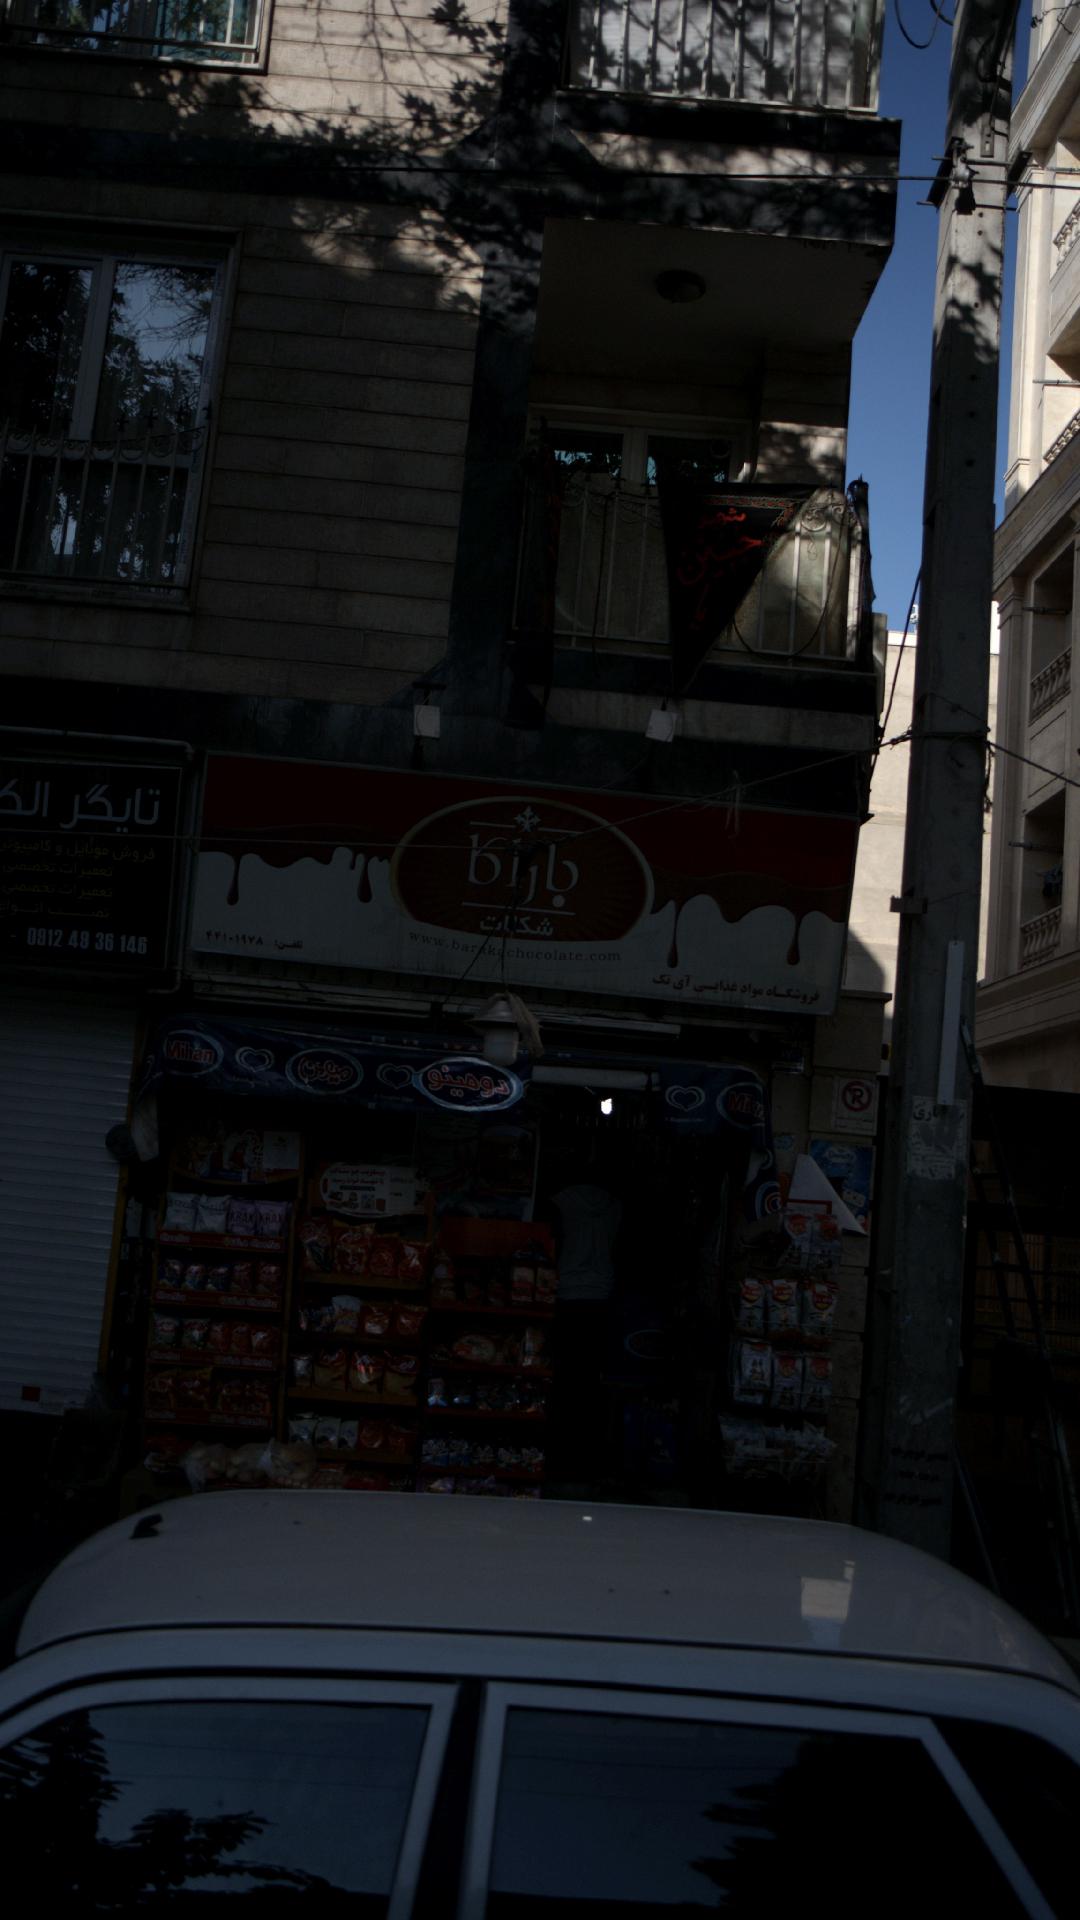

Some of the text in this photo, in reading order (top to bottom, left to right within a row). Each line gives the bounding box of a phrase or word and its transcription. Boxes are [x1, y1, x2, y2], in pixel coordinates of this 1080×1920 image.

[58, 783, 161, 833] تایگر
[112, 844, 157, 864] فروش
[27, 927, 64, 948] 0912
[95, 931, 115, 952] 36
[120, 934, 149, 955] 146
[740, 983, 764, 999] مواد
[427, 1065, 511, 1099] دومینو
